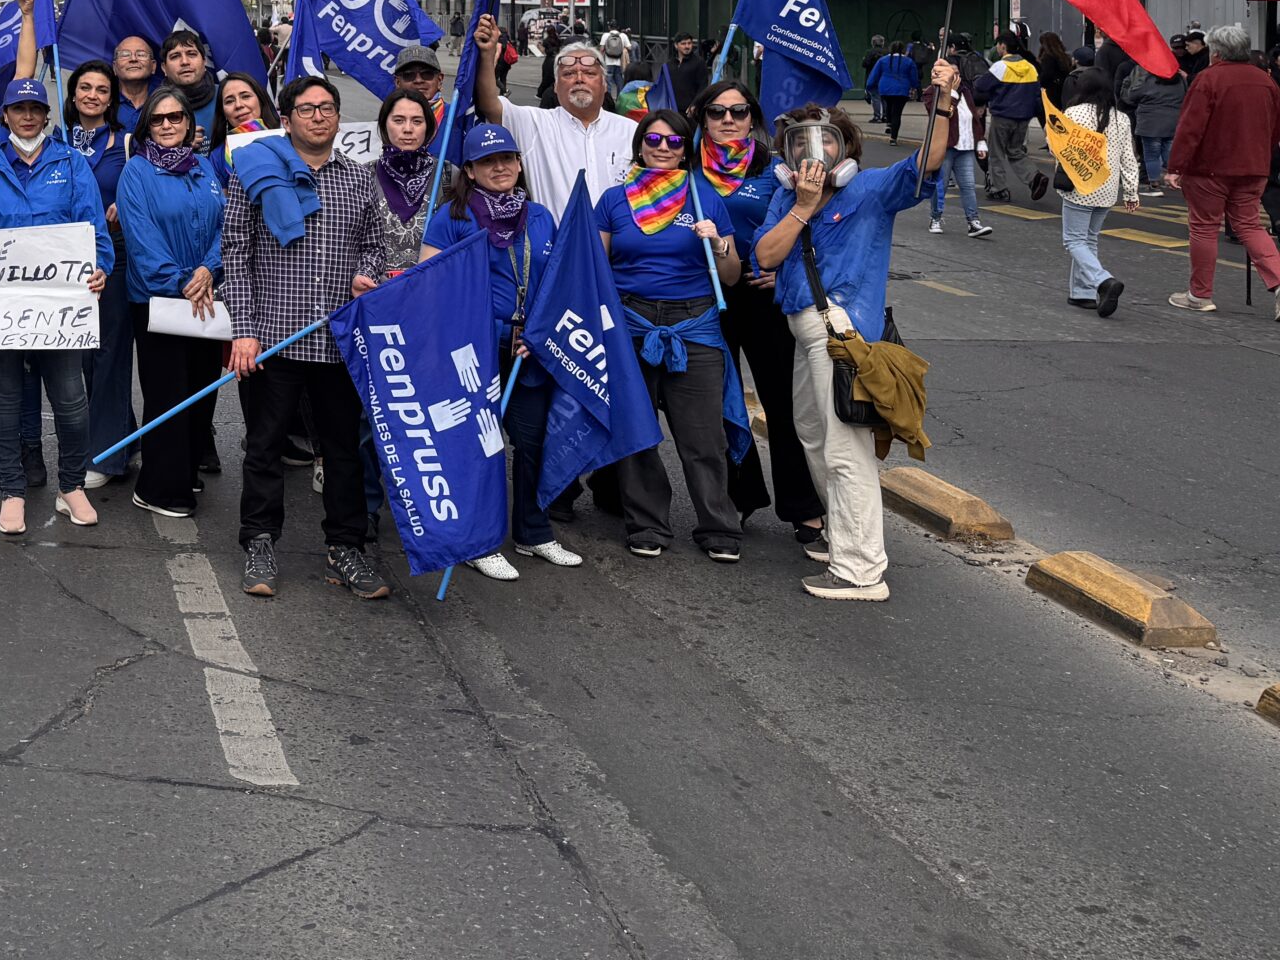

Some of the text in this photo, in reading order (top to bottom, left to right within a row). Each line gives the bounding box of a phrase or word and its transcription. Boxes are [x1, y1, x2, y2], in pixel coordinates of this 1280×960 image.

[766, 33, 837, 72] Universitarios de los
[771, 24, 823, 51] Confederación
[1070, 128, 1081, 139] EL
[1060, 148, 1093, 182] EDUCANDO
[369, 324, 458, 521] Fenpruss
[384, 443, 425, 537] DE LA SALUD
